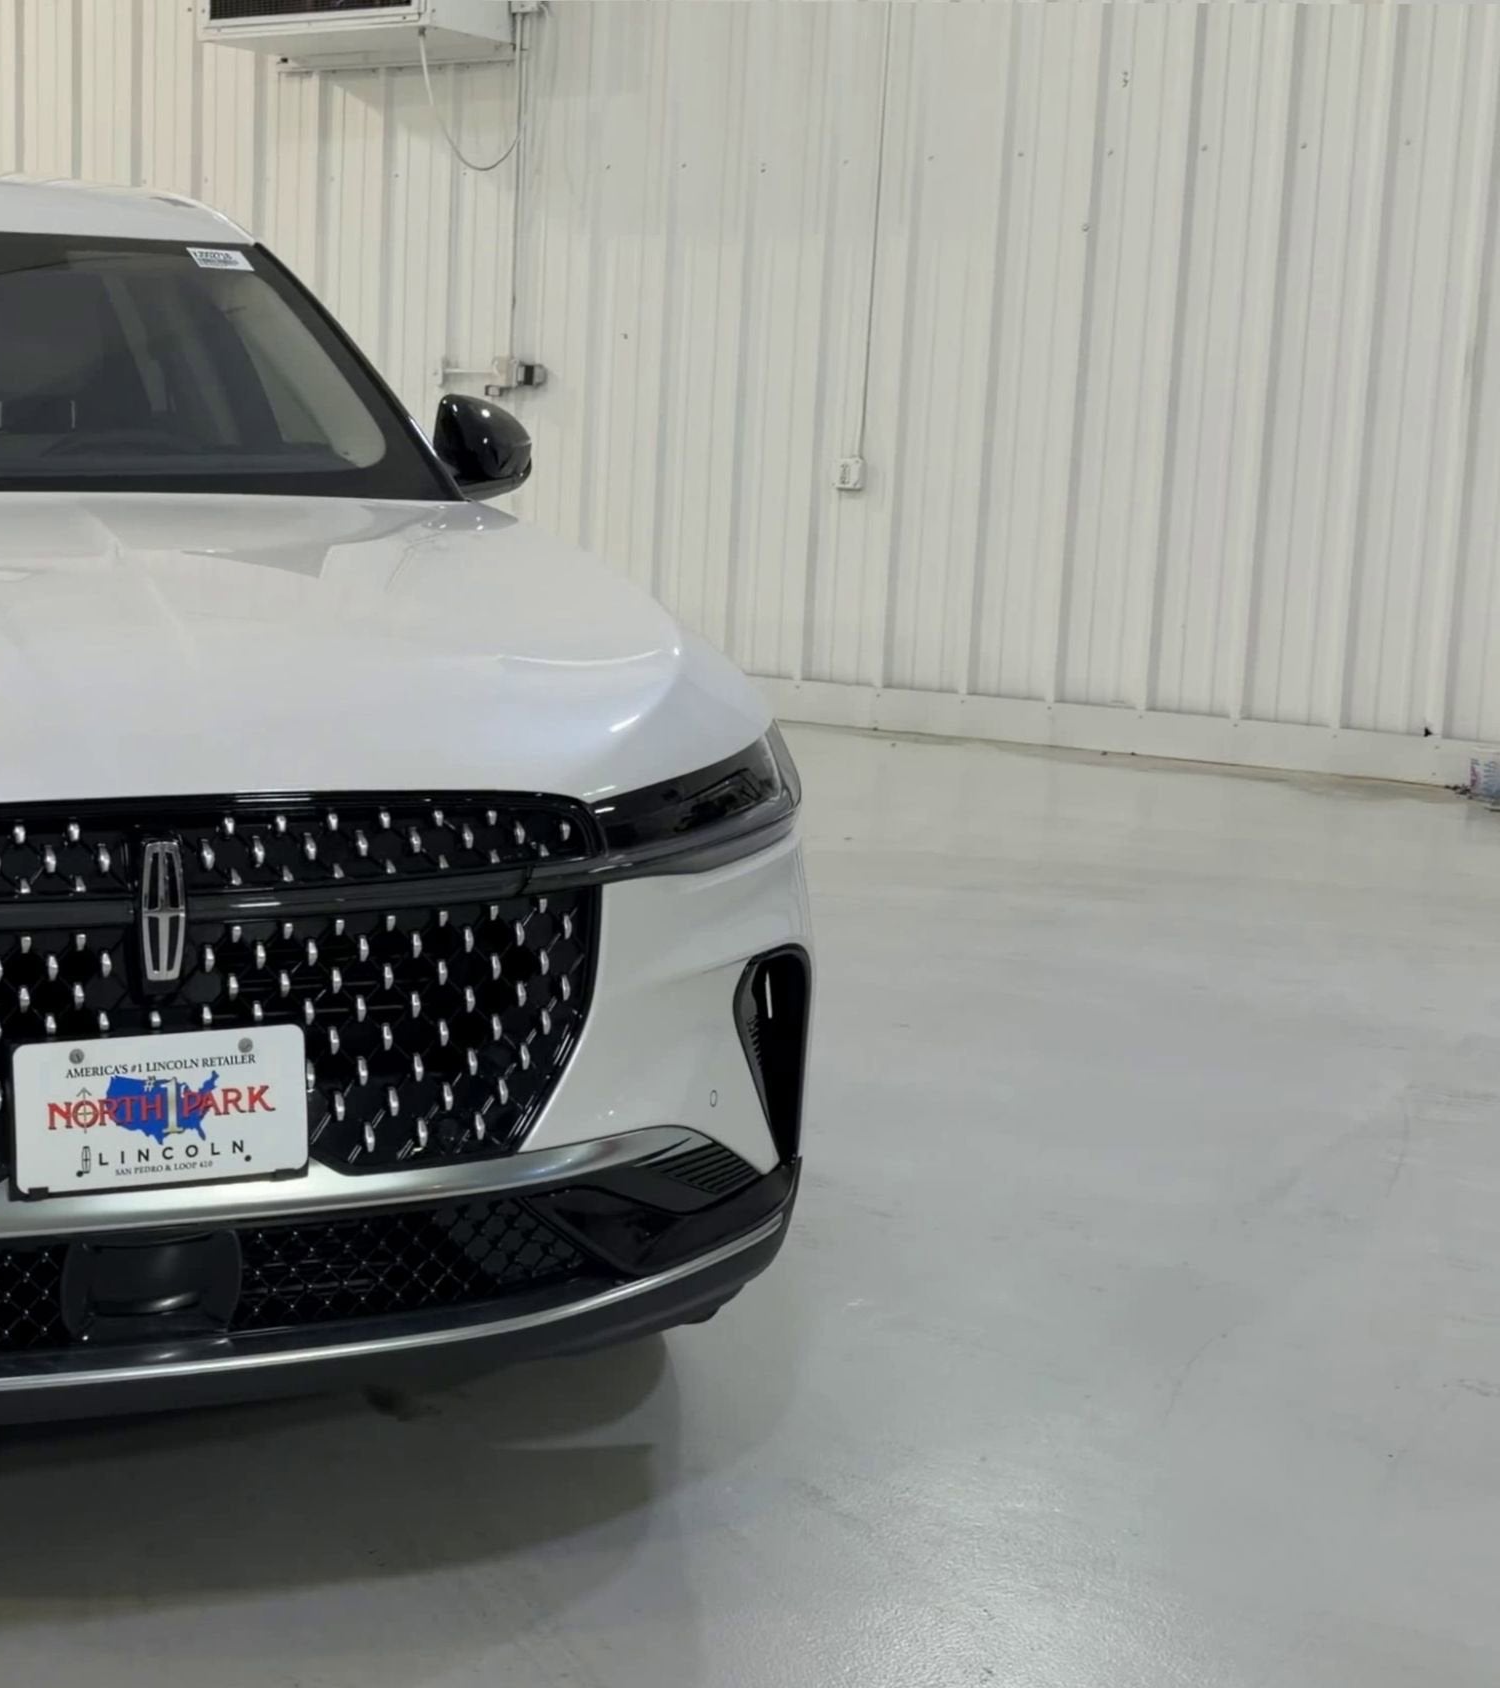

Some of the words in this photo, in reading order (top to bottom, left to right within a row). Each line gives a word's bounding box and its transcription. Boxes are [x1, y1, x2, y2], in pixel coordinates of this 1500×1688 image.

[65, 1063, 129, 1080] AMERICA'S
[130, 1062, 143, 1074] #1
[145, 1058, 200, 1073] LINCOLN
[201, 1053, 257, 1068] RETAILER
[47, 1093, 165, 1131] NORTH
[182, 1084, 277, 1118] PARK
[98, 1139, 245, 1167] LINCOLN
[115, 1167, 132, 1177] SAN
[133, 1164, 164, 1175] PEDRO
[164, 1163, 173, 1172] &
[174, 1161, 198, 1171] LOOP
